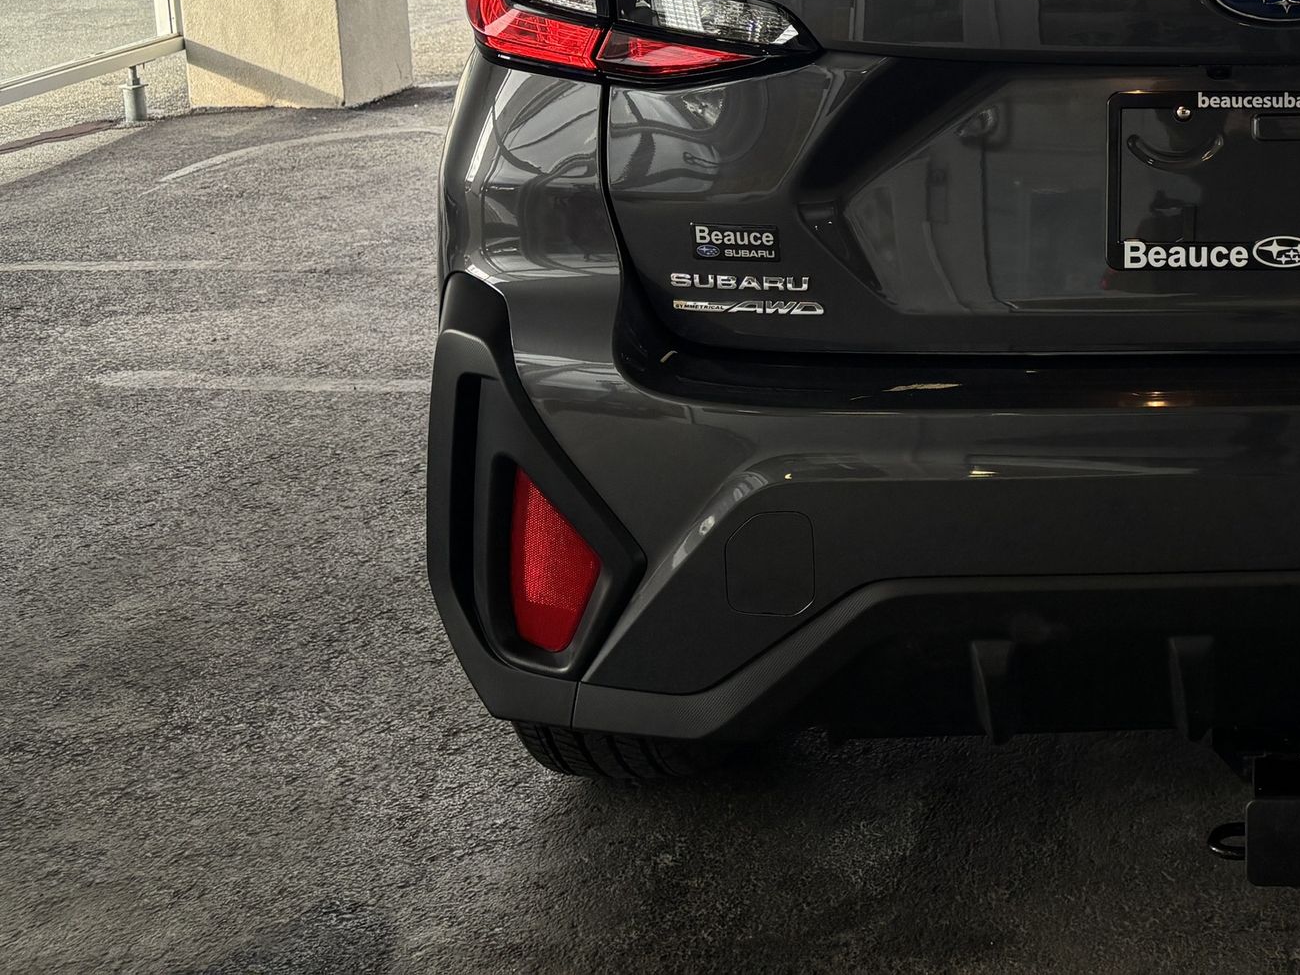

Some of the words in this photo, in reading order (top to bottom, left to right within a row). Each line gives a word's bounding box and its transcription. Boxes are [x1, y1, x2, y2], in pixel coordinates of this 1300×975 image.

[695, 225, 774, 246] Beauce
[724, 249, 775, 258] SUBARU
[1123, 241, 1249, 269] Beauce
[670, 272, 810, 292] SUBARU
[675, 303, 725, 311] SYMMETRICAL
[727, 300, 825, 315] AWD
